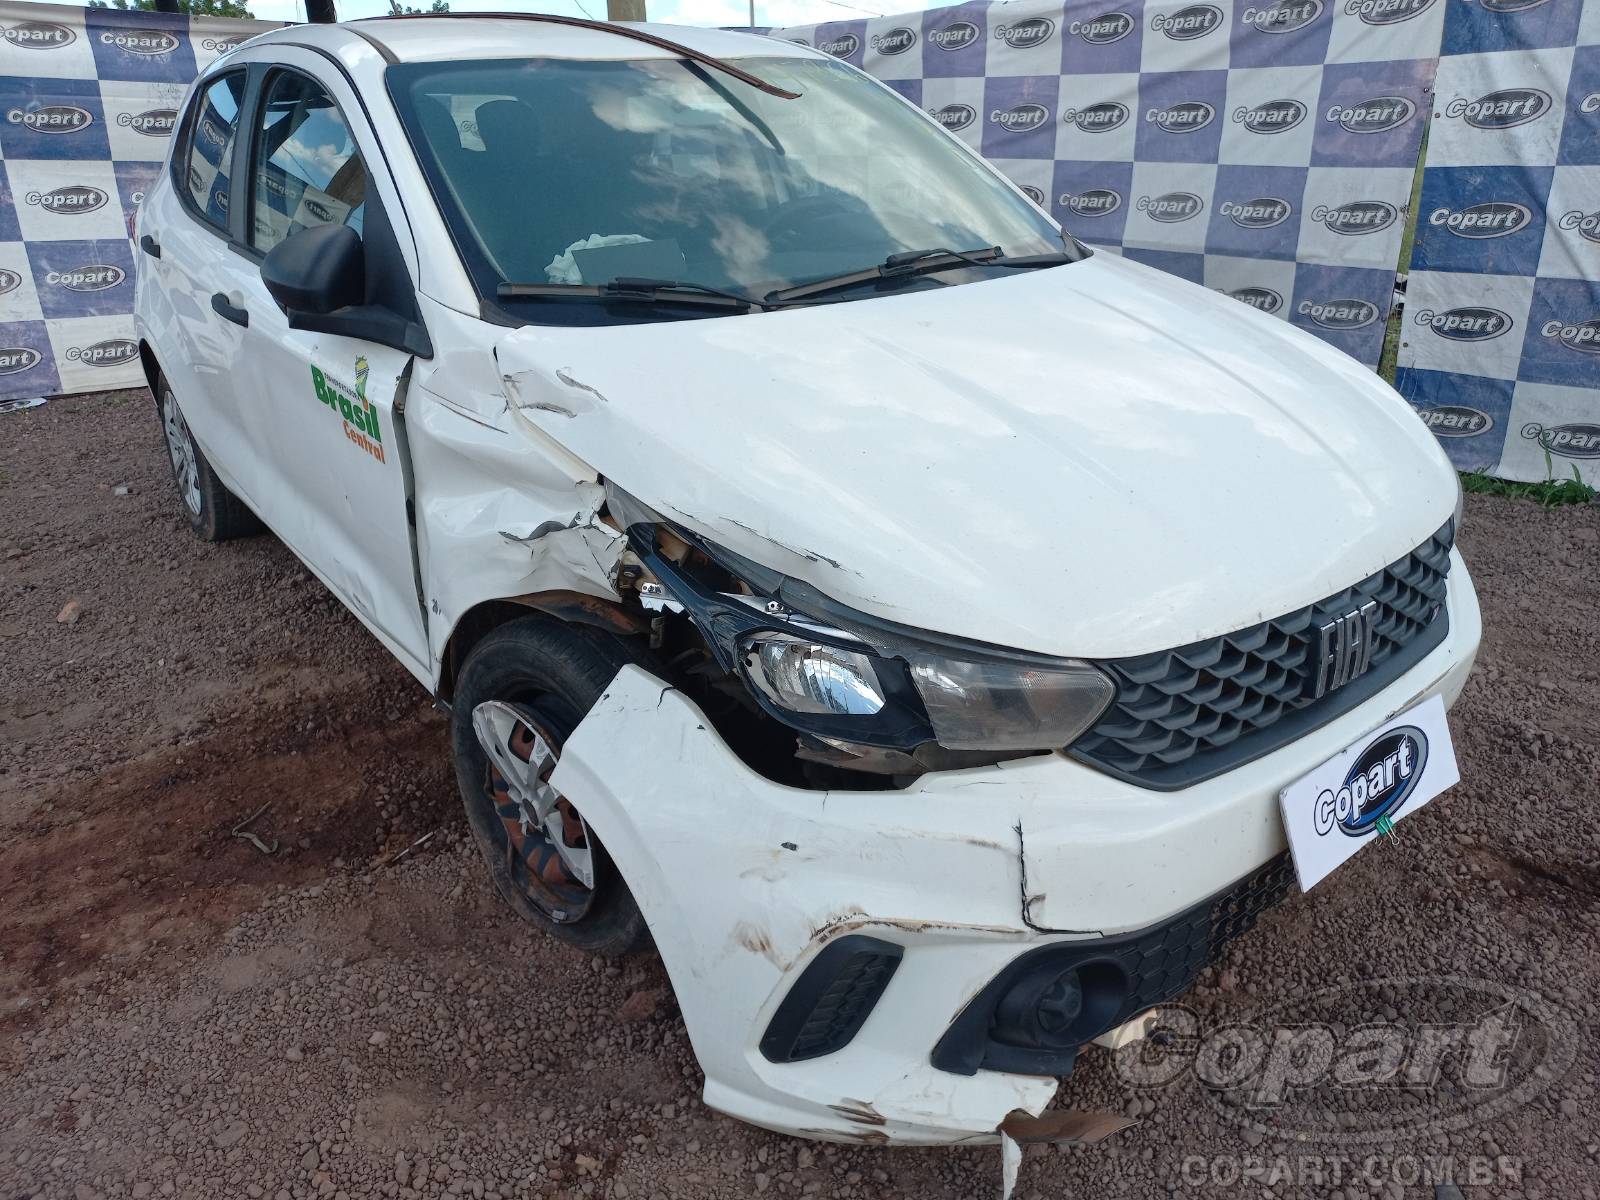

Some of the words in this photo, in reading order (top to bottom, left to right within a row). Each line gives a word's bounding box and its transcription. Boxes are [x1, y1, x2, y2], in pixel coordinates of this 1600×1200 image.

[1151, 12, 1213, 31] Copart
[1242, 2, 1312, 27] Copart
[928, 27, 972, 44] Copart
[994, 22, 1045, 41] Copart
[1069, 18, 1125, 38] Copart
[100, 32, 170, 49] Copart
[818, 38, 855, 55] Copart
[871, 34, 910, 49] Copart
[7, 109, 82, 126] Copart
[1063, 108, 1120, 128] Copart
[1146, 108, 1205, 127] Copart
[1232, 106, 1297, 125] Copart
[1326, 102, 1402, 124] Copart
[1446, 96, 1538, 120] Copart
[990, 109, 1041, 128] Copart
[26, 191, 96, 208] Copart
[1058, 193, 1114, 210] Copart
[1136, 195, 1194, 214] Copart
[1219, 201, 1282, 222] Copart
[1311, 205, 1386, 226] Copart
[1429, 208, 1517, 230] Copart
[46, 268, 117, 287] Copart
[1298, 300, 1370, 321] Copart
[1415, 310, 1500, 333] Copart
[66, 341, 133, 361] Copart
[311, 364, 382, 443] Brasil
[342, 420, 386, 464] Central
[1315, 600, 1377, 699] FIAT
[1314, 733, 1412, 837] Copart
